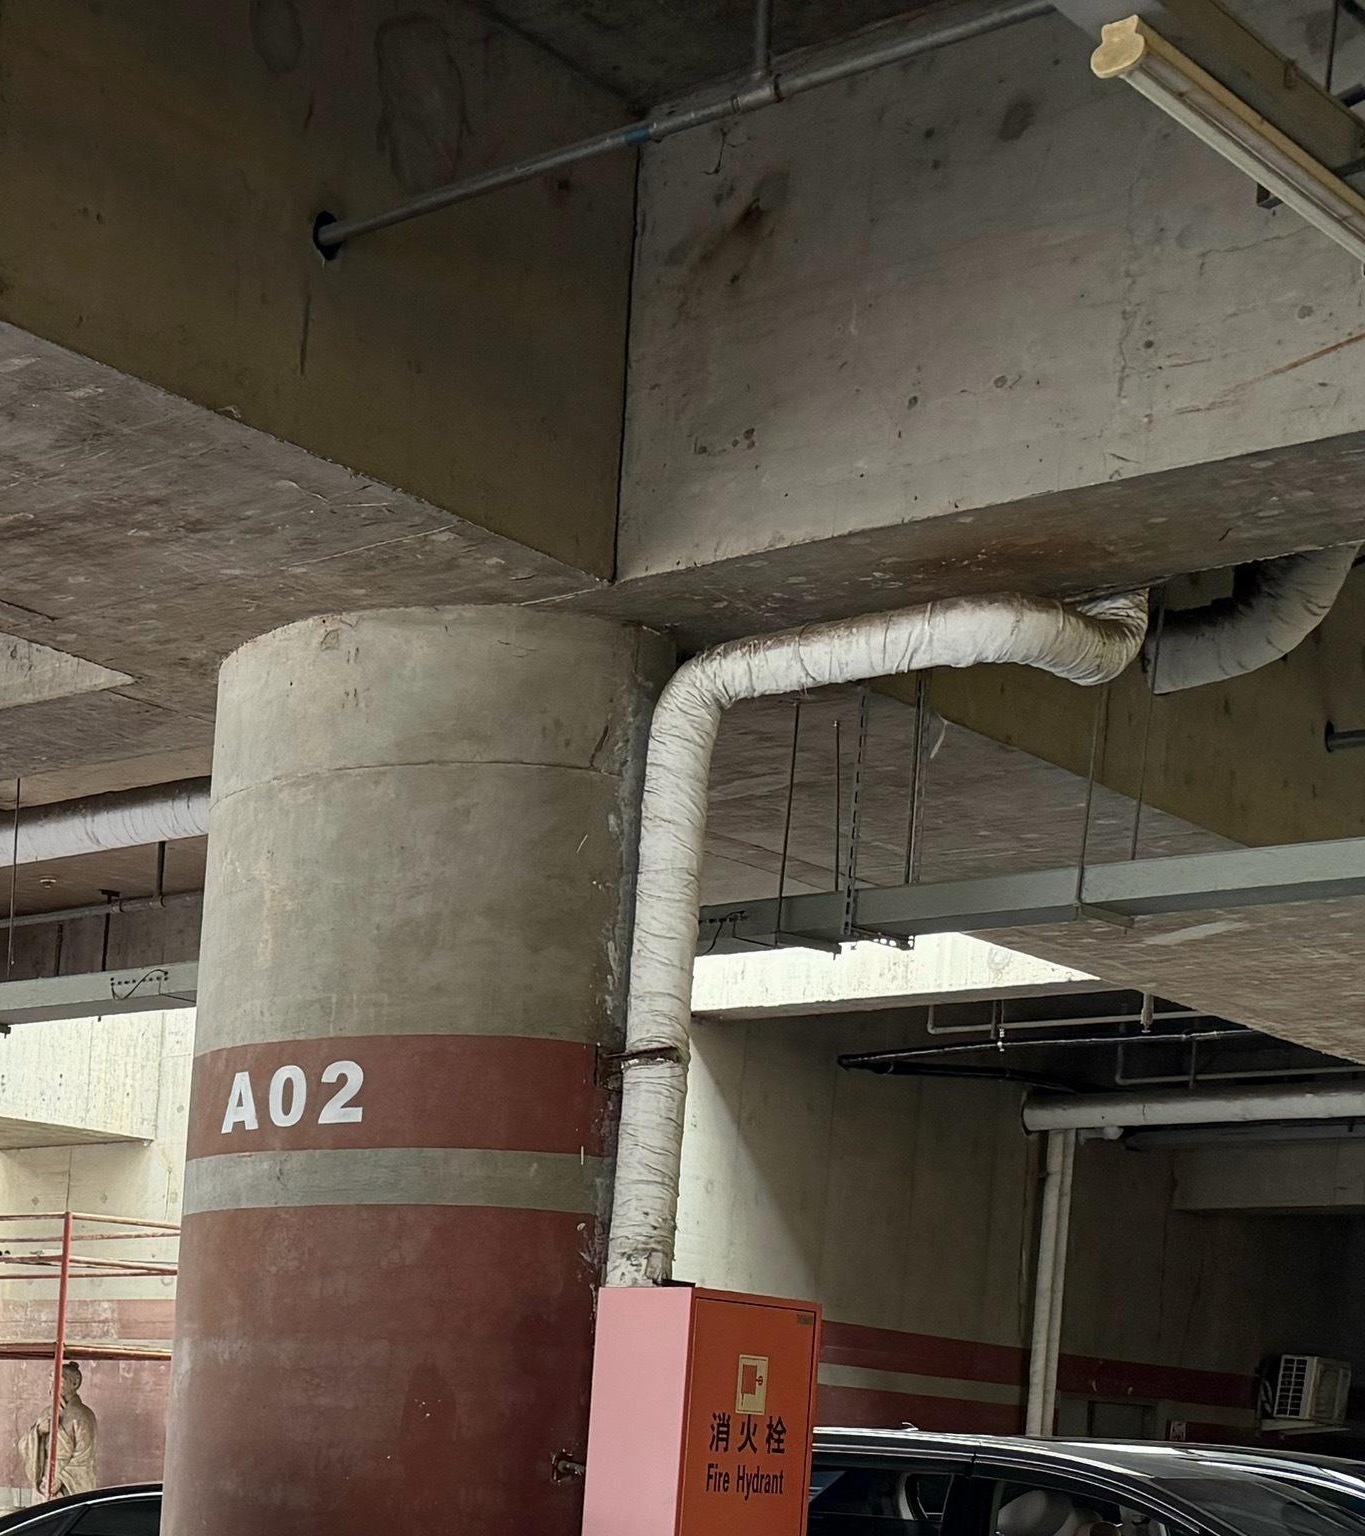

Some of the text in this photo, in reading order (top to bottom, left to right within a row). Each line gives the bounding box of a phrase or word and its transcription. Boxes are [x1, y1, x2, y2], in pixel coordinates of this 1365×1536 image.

[221, 1061, 364, 1134] A02
[709, 1412, 787, 1454] 消火栓
[706, 1463, 784, 1500] Fire Hydrant
